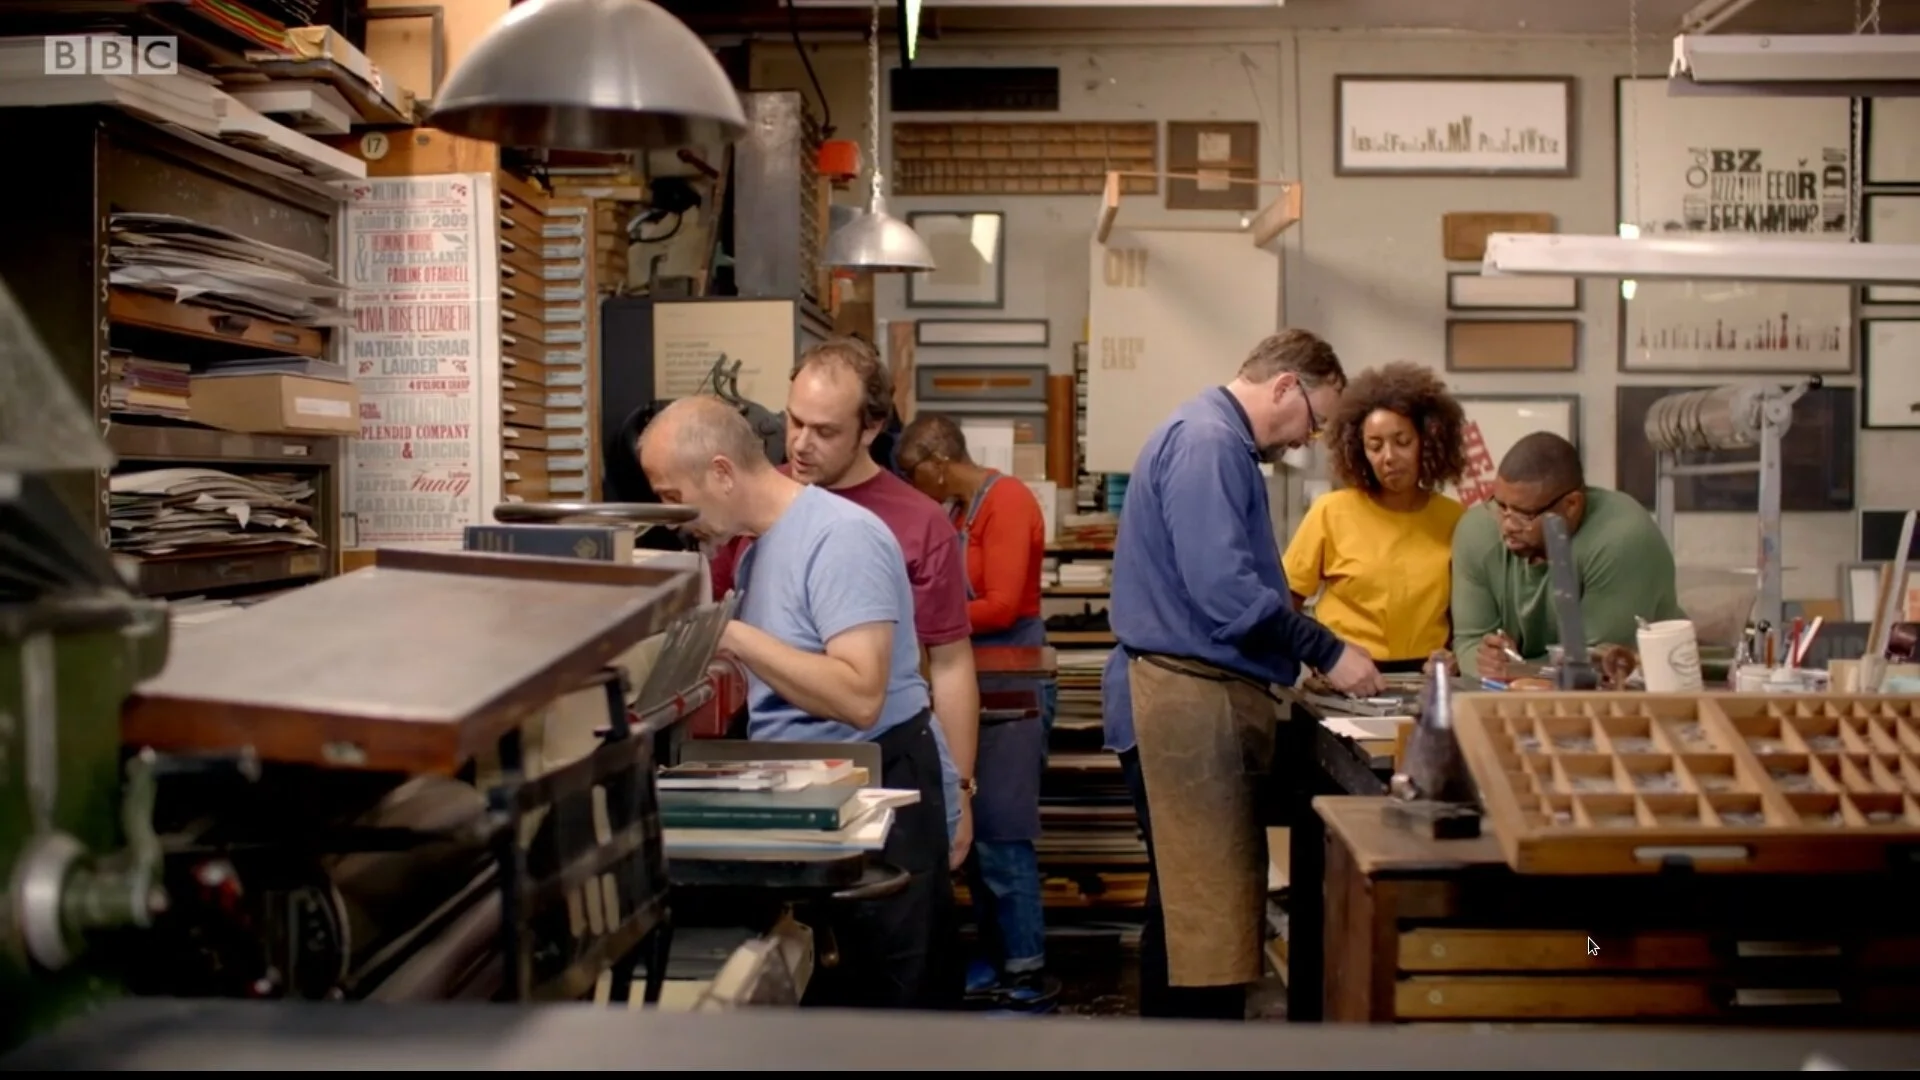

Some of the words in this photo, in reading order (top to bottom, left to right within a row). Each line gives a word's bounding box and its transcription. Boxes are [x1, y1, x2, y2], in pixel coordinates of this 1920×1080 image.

[367, 136, 381, 152] 17
[432, 213, 469, 228] 2009
[102, 244, 109, 266] 2
[372, 252, 404, 265] LORD
[387, 266, 421, 283] PAULINE
[101, 279, 109, 302] 3
[388, 305, 414, 332] ROSE
[417, 304, 470, 332] ELIZABETH
[100, 317, 109, 339] 4
[355, 340, 414, 358] NATHAN
[418, 340, 470, 356] USMAR
[101, 351, 109, 374] 5
[382, 358, 438, 376] LAUDER
[101, 384, 109, 408] 6
[359, 425, 412, 440] PLENDID
[415, 423, 470, 440] COMPANY
[402, 441, 413, 459] &
[414, 441, 470, 458] DANCING
[411, 468, 471, 498] Fancy
[355, 497, 445, 513] CARRIAGES
[449, 498, 470, 512] AT
[373, 513, 455, 529] MIDNIGHT
